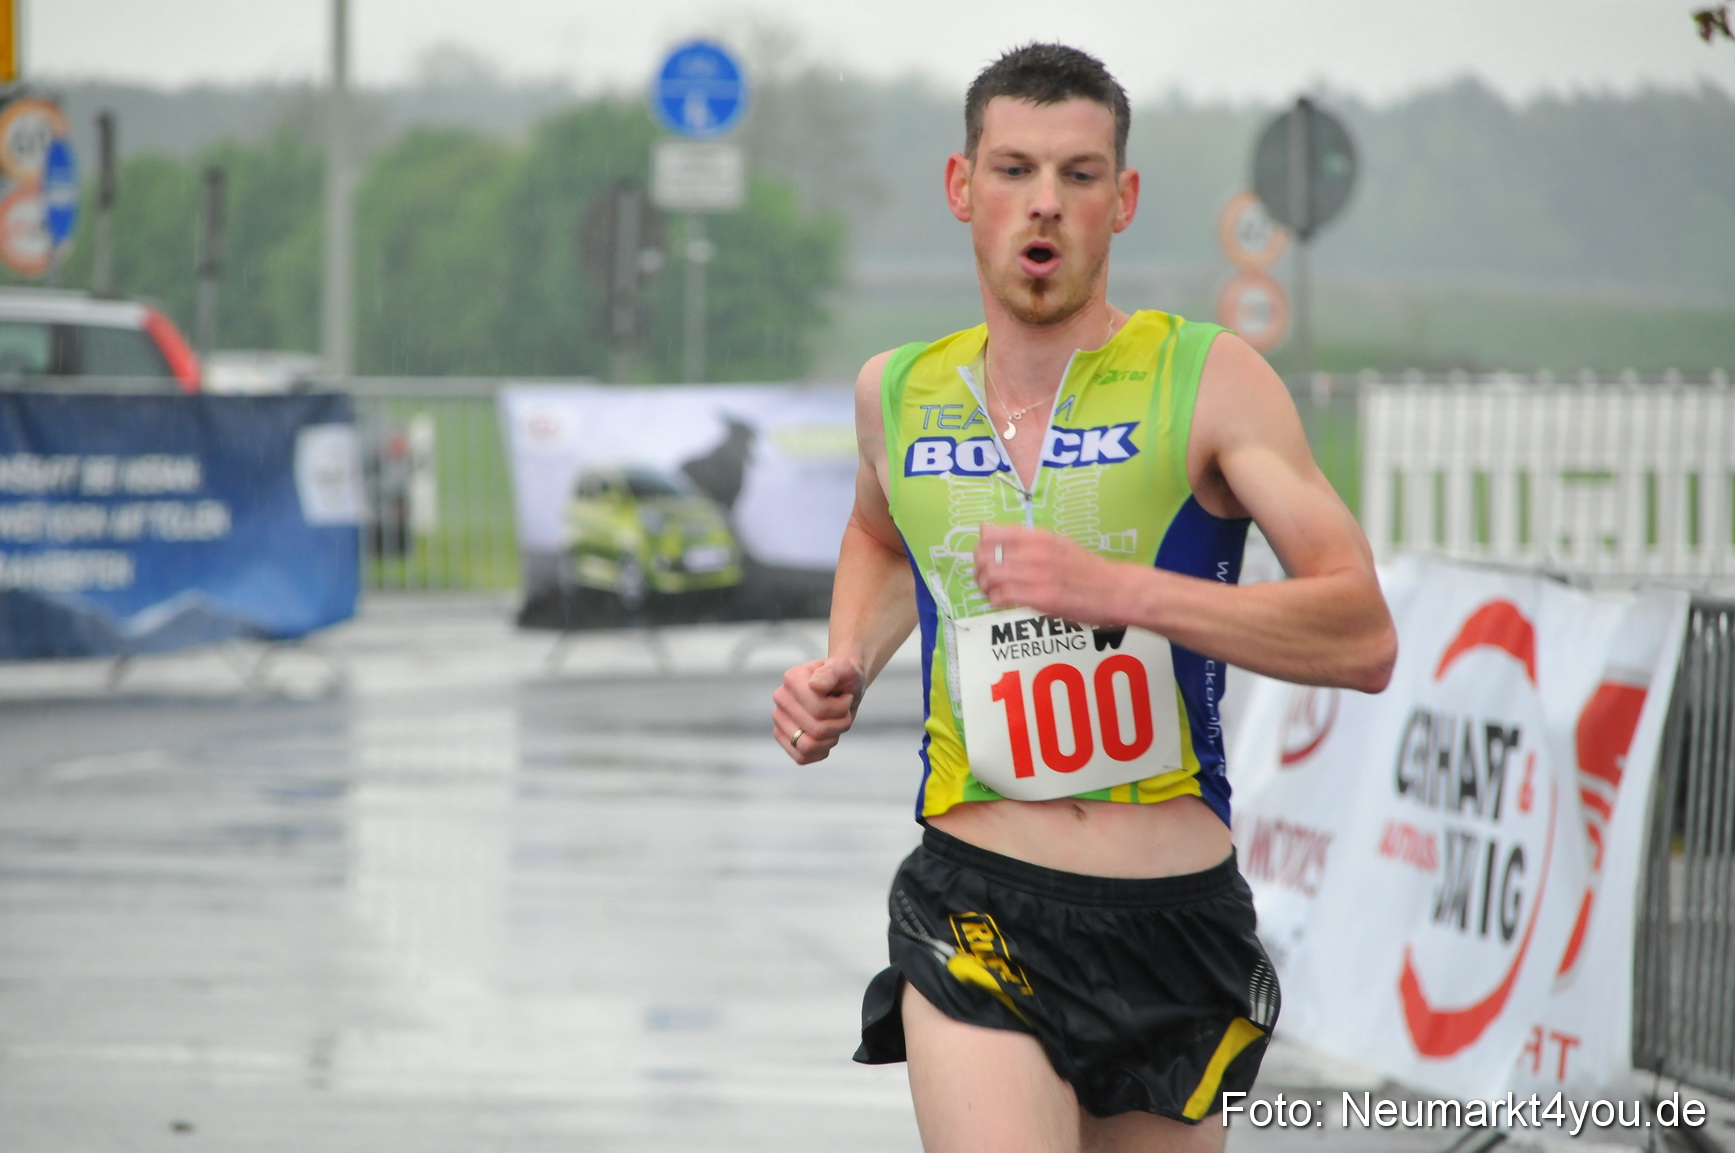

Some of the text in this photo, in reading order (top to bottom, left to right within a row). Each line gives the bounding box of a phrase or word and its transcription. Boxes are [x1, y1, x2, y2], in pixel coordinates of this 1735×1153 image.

[990, 614, 1084, 646] MEYER
[992, 634, 1087, 661] WERBUNG
[990, 653, 1154, 779] 100
